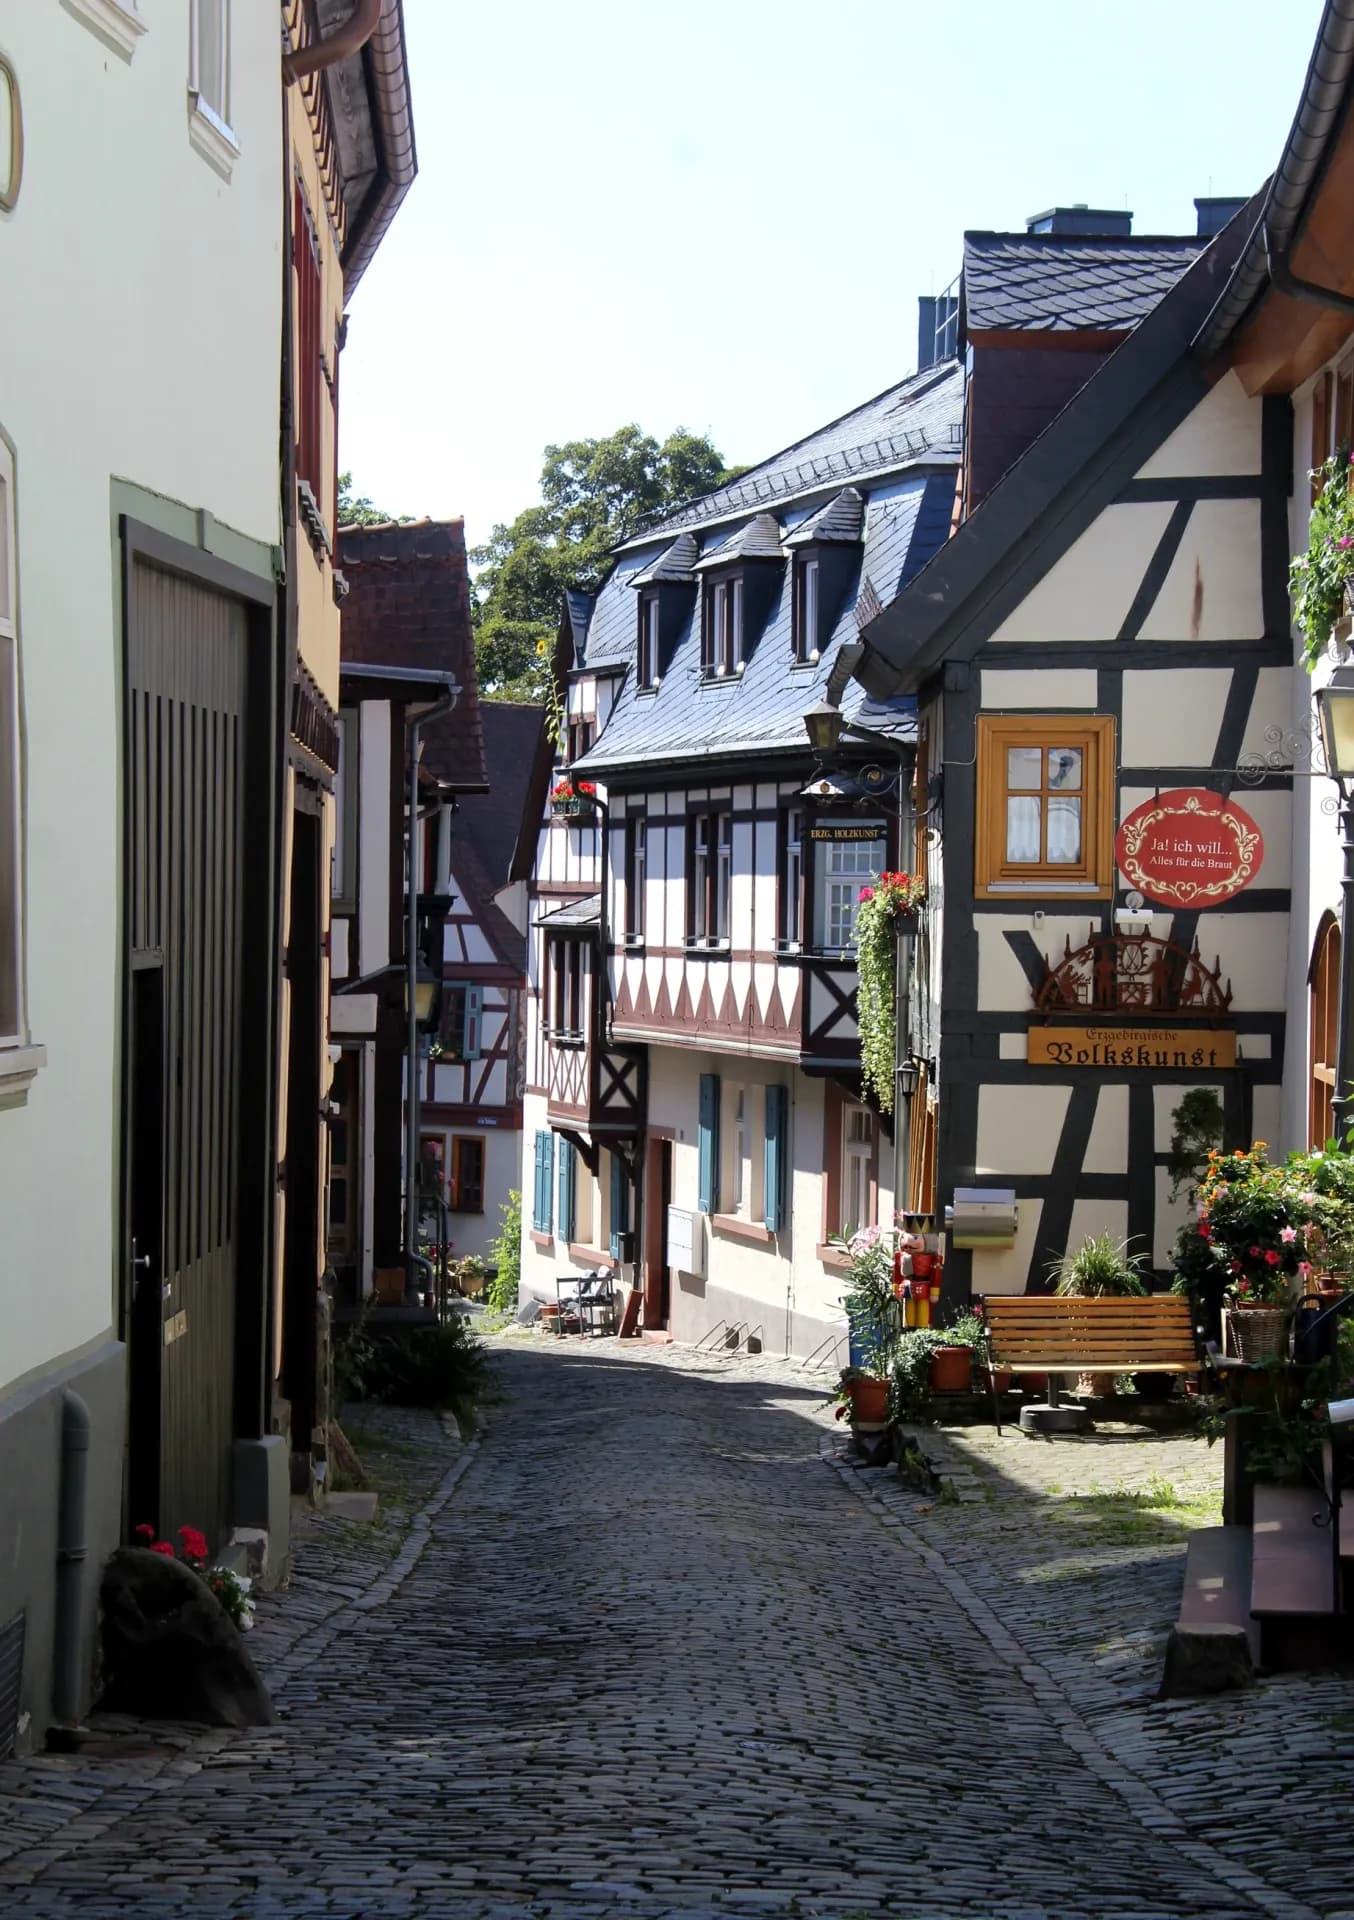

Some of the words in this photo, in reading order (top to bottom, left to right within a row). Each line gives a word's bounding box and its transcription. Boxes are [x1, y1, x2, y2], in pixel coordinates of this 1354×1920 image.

[834, 829, 879, 839] HOLZKUNST
[1151, 838, 1169, 851] Ja!
[1174, 839, 1192, 853] ich
[1196, 841, 1232, 855] will...
[1150, 855, 1173, 865] Alles
[1176, 856, 1190, 866] für
[1191, 857, 1206, 867] die
[1207, 858, 1232, 869] Braut
[1085, 1028, 1178, 1042] Erzgebirgische
[1046, 1042, 1217, 1067] Volkskunst
